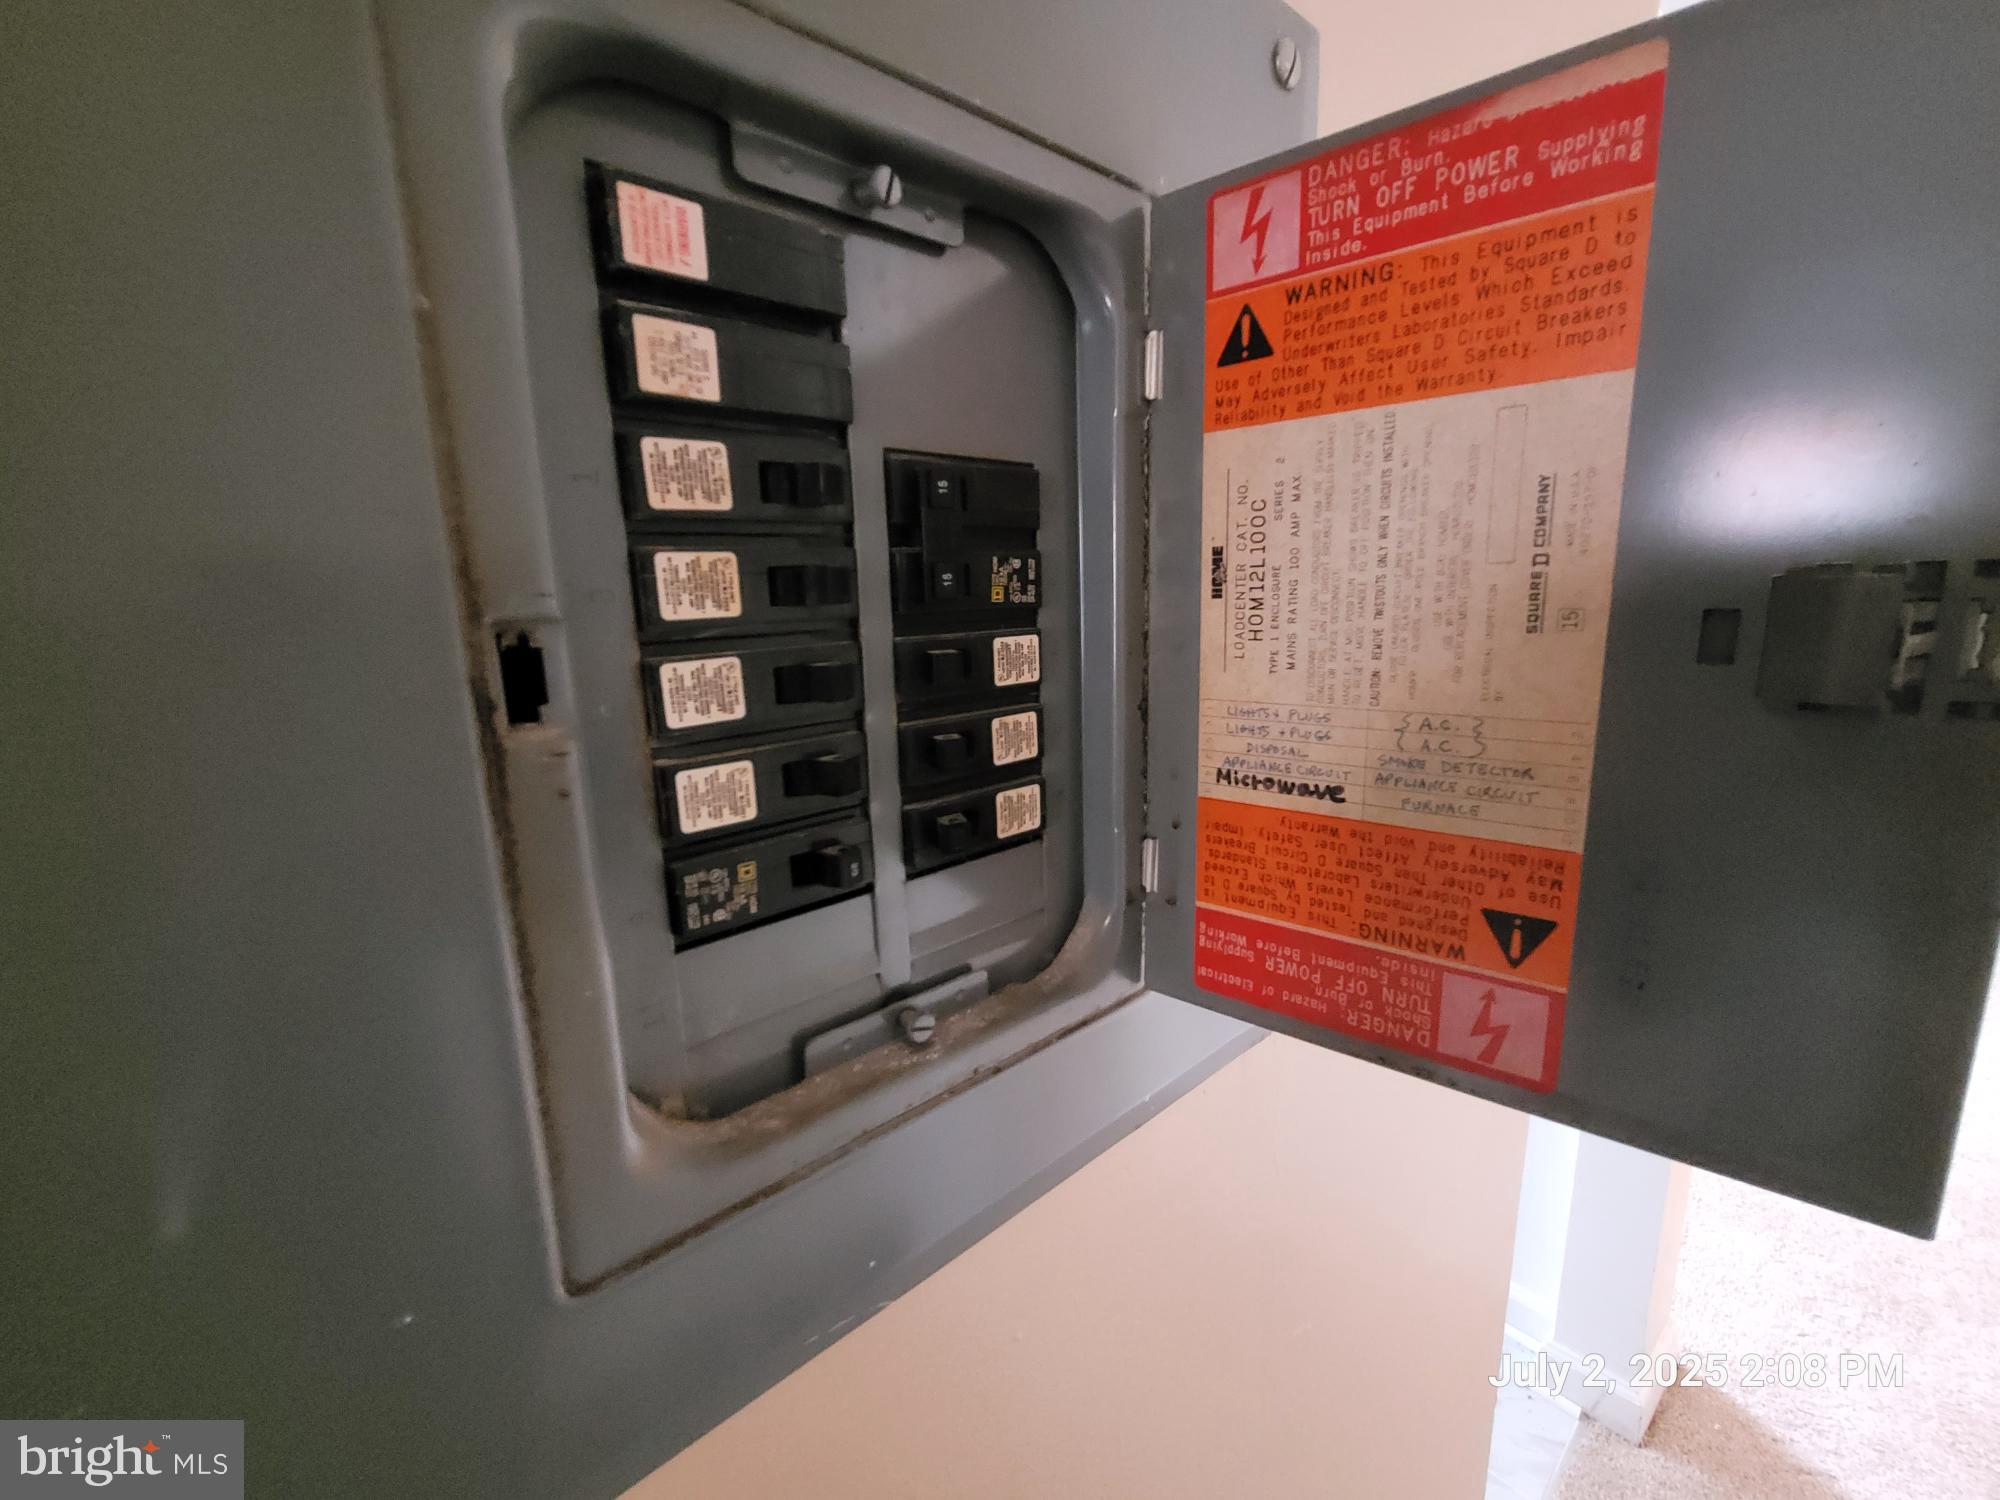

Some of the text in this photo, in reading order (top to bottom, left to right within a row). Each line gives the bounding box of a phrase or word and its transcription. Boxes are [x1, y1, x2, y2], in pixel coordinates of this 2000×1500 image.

[1308, 137, 1410, 188] DANGER:
[1308, 114, 1647, 229] TURN OFF POWER Supplying
[1308, 151, 1450, 206] Shock or Burn.
[1307, 139, 1643, 248] This Equipment Before Working
[1285, 207, 1638, 306] WARNING: This Equipment is
[1305, 239, 1367, 266] Inside.
[1284, 230, 1636, 326] Designed and Tested by Square D to
[1283, 253, 1633, 343] Performance Levels Which Exceed
[1215, 300, 1628, 393] Use of Other Than Square D Circuit Breakers
[1282, 331, 1381, 362] Underwriters
[1392, 304, 1505, 339] Laboratories
[1215, 323, 1627, 409] May Adversely Affect User Safety. Impair
[1215, 406, 1286, 425] Reliability
[1296, 397, 1323, 410] and
[1378, 384, 1404, 399] the
[1273, 480, 1284, 521] SERIES
[1379, 468, 1393, 511] CIRCUITS
[1290, 512, 1300, 537] AMP
[1377, 515, 1390, 540] WHEN
[1233, 480, 1249, 660] LOADCENTER CAT. NO.
[1248, 499, 1266, 641] HOM12L100C
[1289, 547, 1300, 569] 100
[1376, 546, 1388, 569] ONLY
[1526, 474, 1551, 634] SQUARE D COMPANY
[1270, 564, 1282, 630] ENCLOSURE
[1287, 579, 1299, 624] RATING
[1269, 650, 1280, 674] TYPE
[1286, 633, 1297, 670] MAINS
[1371, 628, 1384, 661] REMOVE
[1222, 756, 1351, 781] APPLIANCE CIRCUIT
[1246, 742, 1310, 758] DISPOSAL
[1377, 753, 1535, 781] SMOKE DETECTOR
[1215, 767, 1347, 804] Microwave
[1374, 772, 1540, 804] APPLIANCE CIRCUIT
[1400, 797, 1481, 817] FURNACE
[1205, 822, 1244, 837] Impair
[1314, 840, 1347, 855] User
[1350, 829, 1373, 843] the
[1428, 841, 1455, 855] and
[1206, 834, 1561, 910] Use of Other Than Square D Circuit Breakers
[1276, 861, 1360, 888] Laboratories
[1359, 846, 1410, 866] Affect
[1424, 854, 1509, 882] Adversely
[1204, 861, 1469, 926] Performance Levels Which Exceed
[1370, 879, 1471, 909] Underwriters
[1526, 872, 1563, 892] May
[1204, 875, 1468, 942] Designed and Tested by Square D to
[1225, 893, 1295, 919] Equipment
[1308, 911, 1336, 928] This
[1200, 921, 1432, 997] This Equipment Before Working
[1351, 921, 1465, 961] WARNING:
[1199, 935, 1431, 1015] TURN OFF POWER Supplying
[1197, 966, 1430, 1049] DANGER: Hazard of Electrical
[1358, 1000, 1373, 1010] or
[1385, 1006, 1431, 1029] Shock
